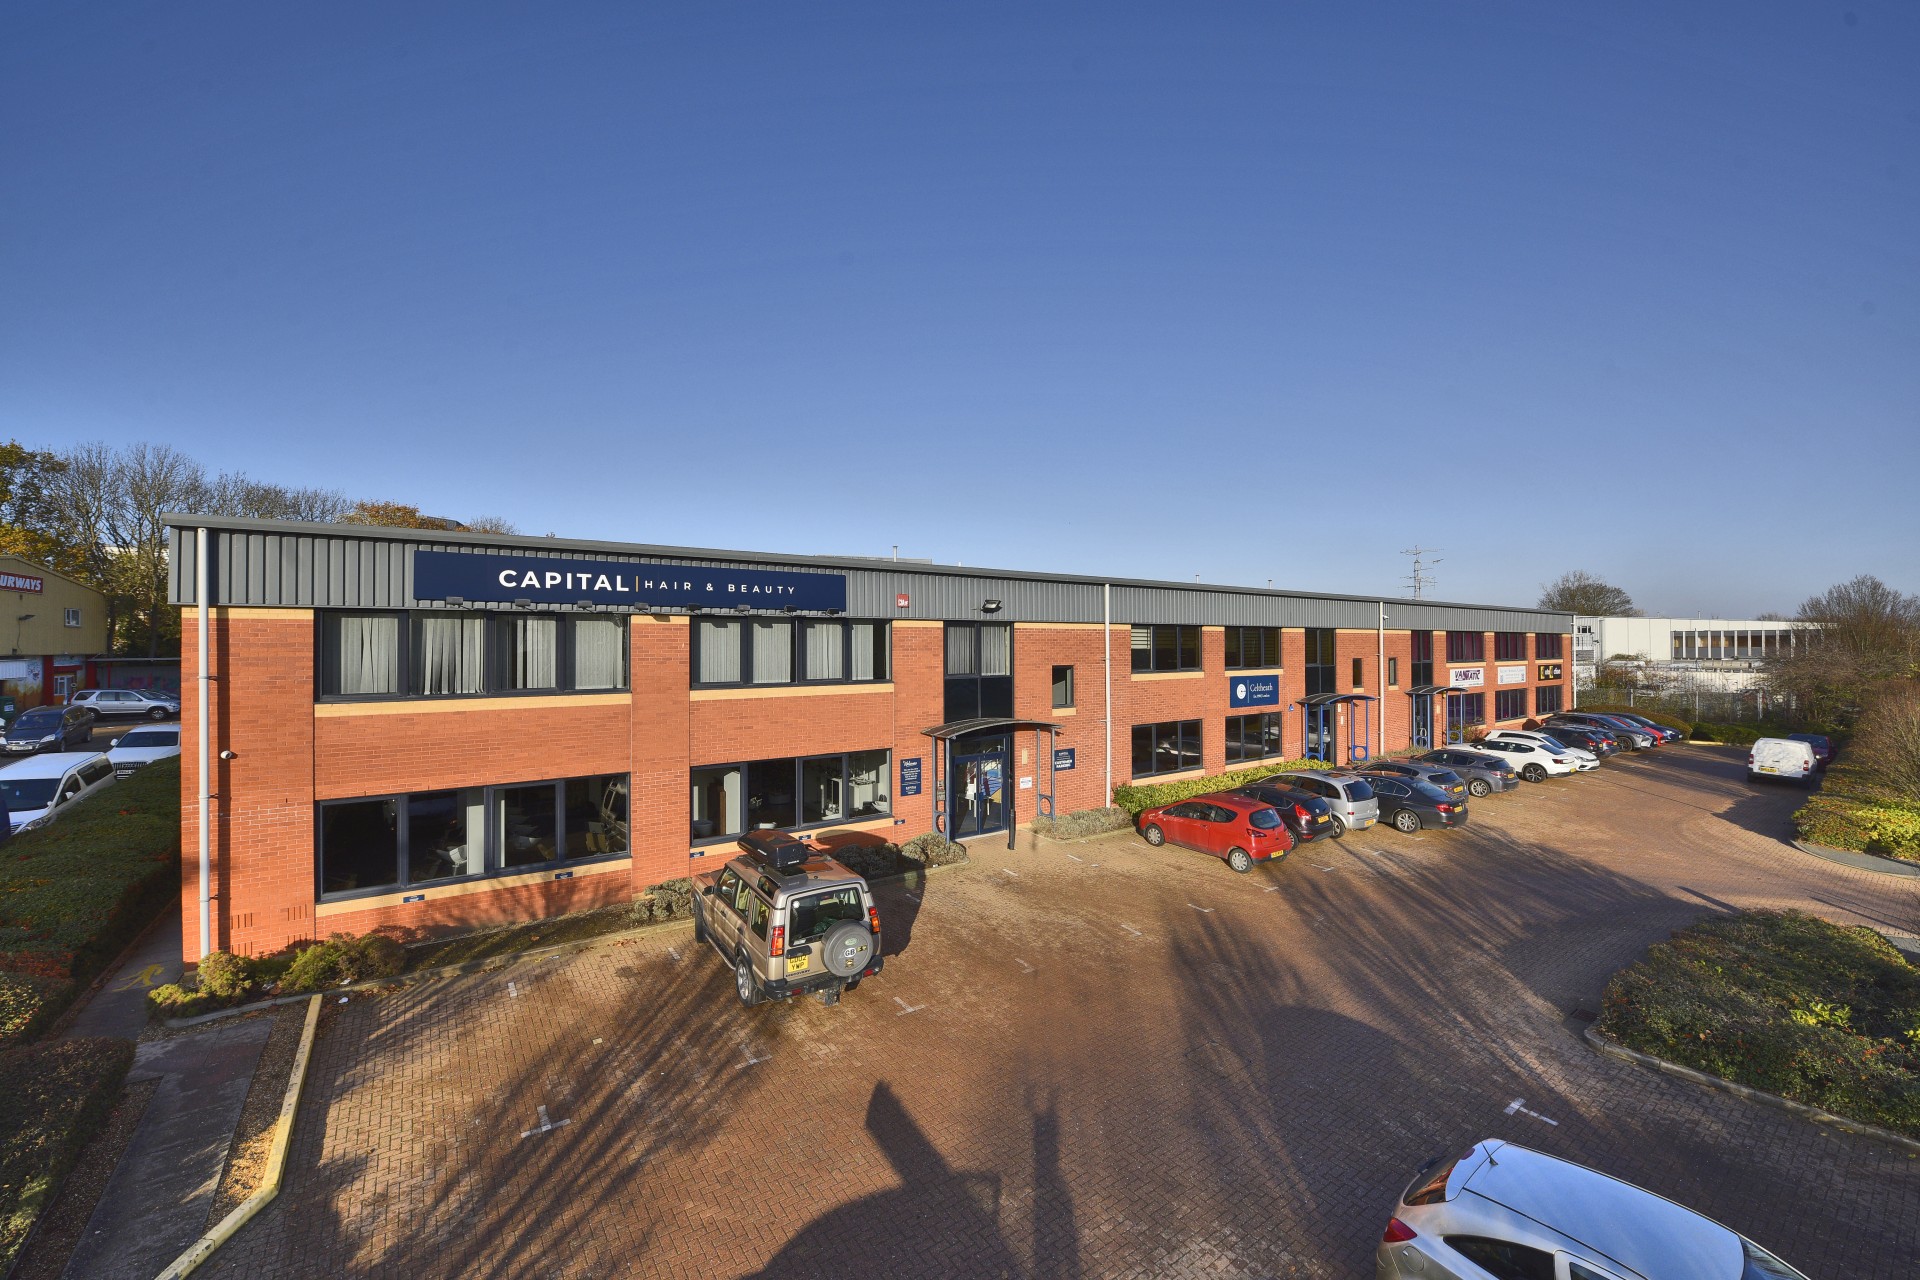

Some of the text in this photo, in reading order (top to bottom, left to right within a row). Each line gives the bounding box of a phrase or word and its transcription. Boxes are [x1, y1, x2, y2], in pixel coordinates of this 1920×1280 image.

[498, 569, 795, 595] CAPITAL HAIR & BEAUTY
[844, 948, 857, 957] GB
[791, 962, 805, 971] YWP
